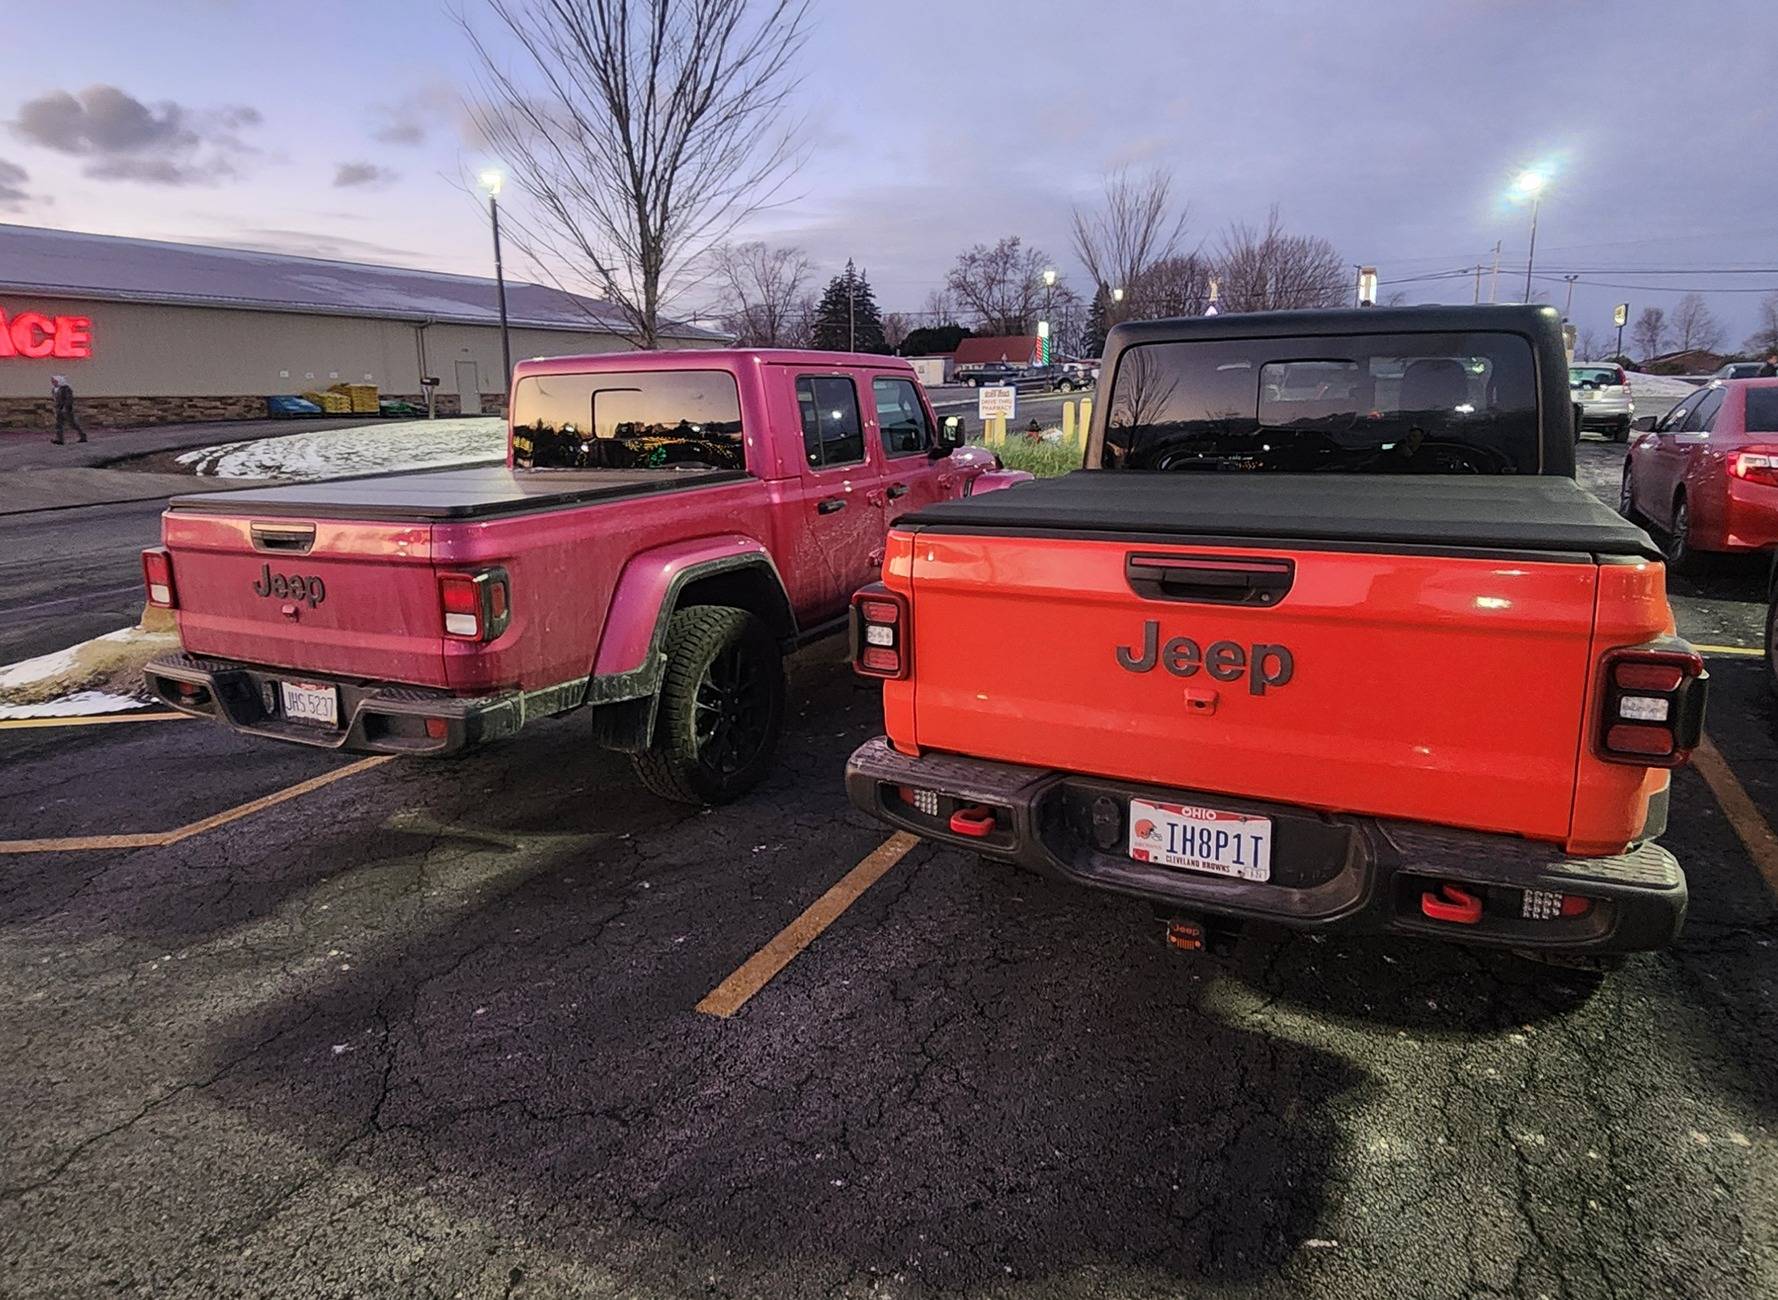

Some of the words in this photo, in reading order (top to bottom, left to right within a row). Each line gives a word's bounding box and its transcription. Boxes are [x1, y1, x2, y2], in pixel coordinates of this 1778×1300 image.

[253, 563, 325, 609] Jeep
[1116, 620, 1294, 696] Jeep
[286, 691, 306, 713] JHS
[308, 694, 334, 717] 5237
[1181, 806, 1217, 820] OHIO
[1166, 822, 1263, 868] IH8P1T
[1165, 855, 1200, 868] CLEVELAND
[1202, 860, 1231, 873] BROWNS
[1172, 923, 1200, 937] Jeep
